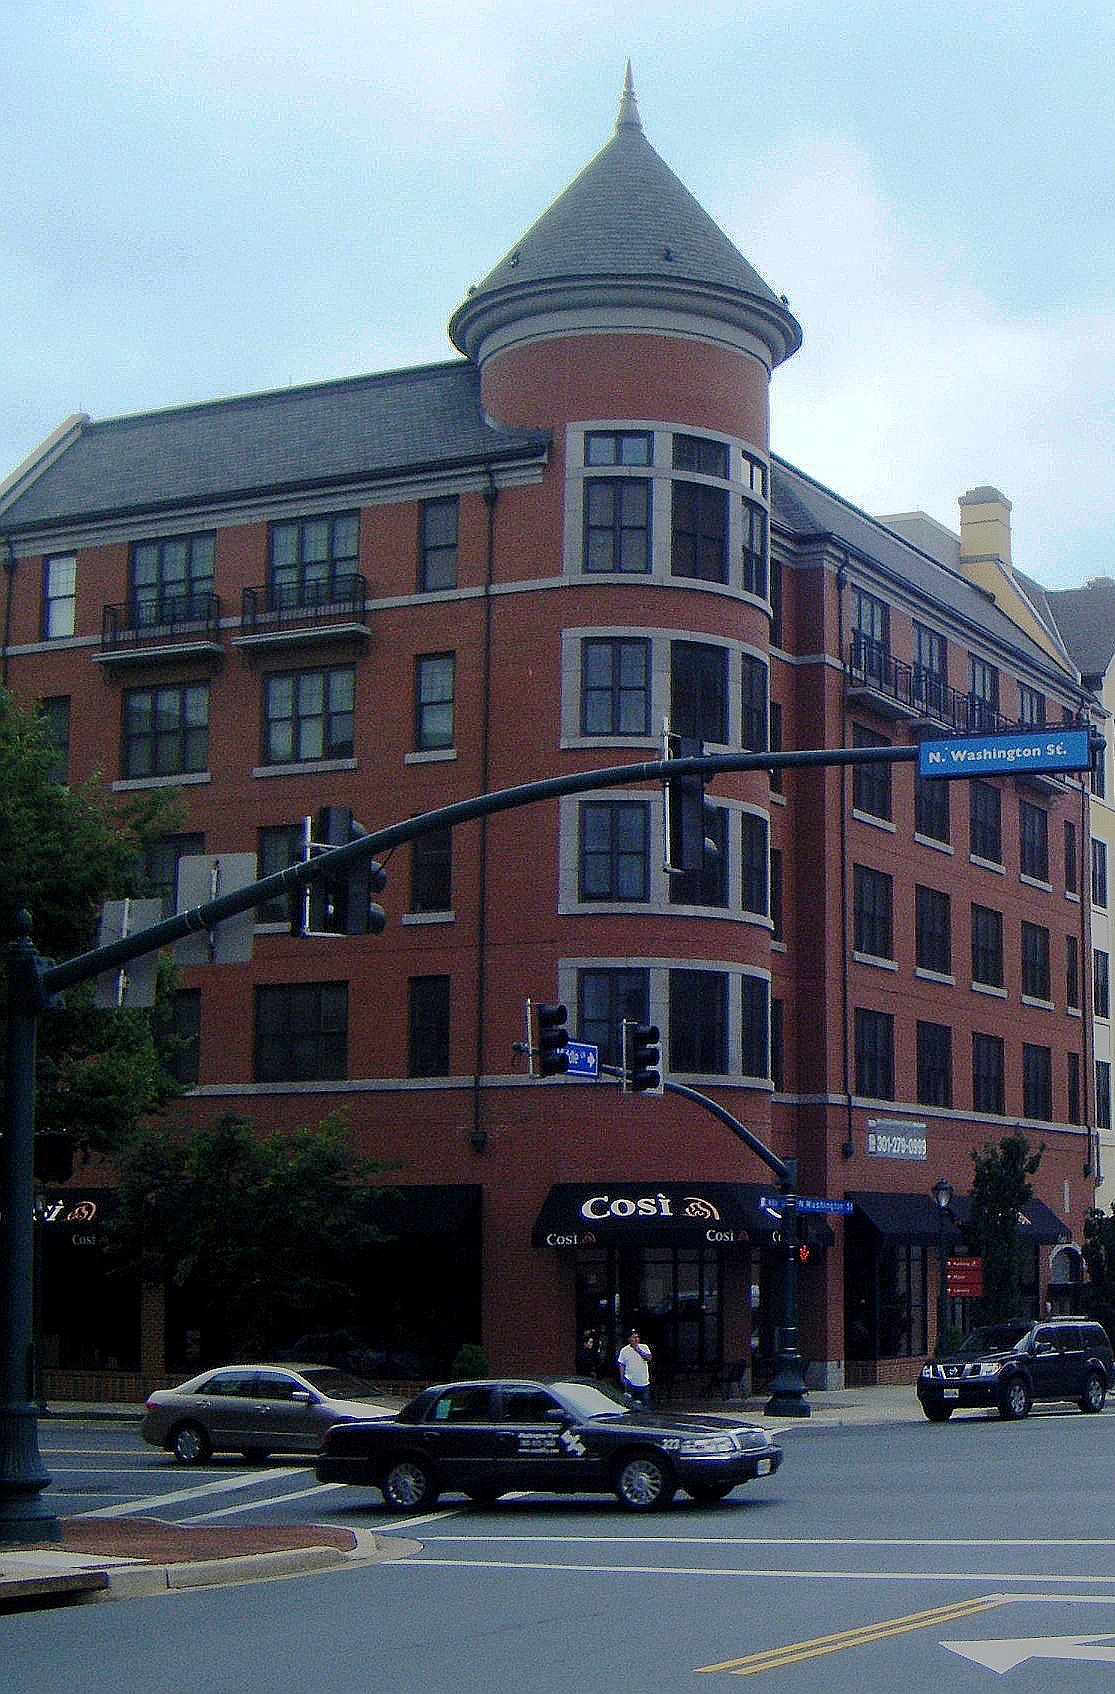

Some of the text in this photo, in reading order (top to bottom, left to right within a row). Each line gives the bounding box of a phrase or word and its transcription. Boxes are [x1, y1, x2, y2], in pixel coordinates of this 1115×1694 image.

[928, 741, 1067, 764] N. Washington St.
